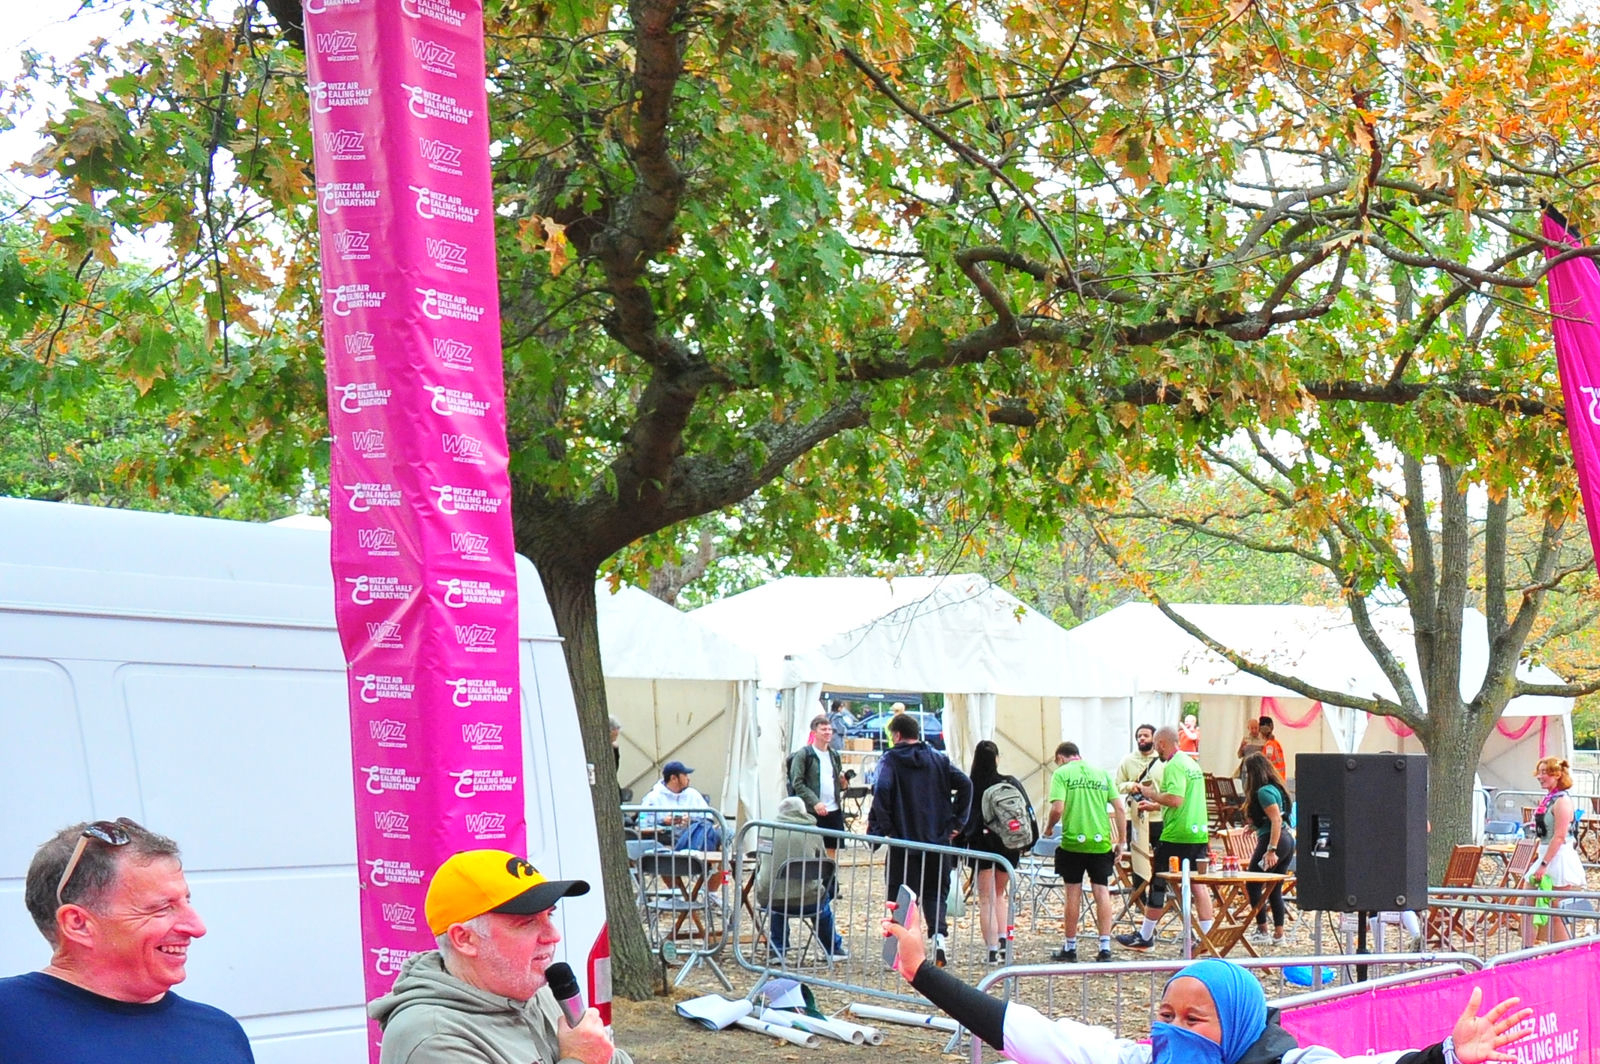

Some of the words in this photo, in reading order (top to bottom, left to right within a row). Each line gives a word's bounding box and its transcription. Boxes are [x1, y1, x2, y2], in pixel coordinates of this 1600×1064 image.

[329, 90, 354, 98] EALING
[424, 91, 444, 103] WIZZ
[444, 96, 456, 106] AIR
[424, 99, 453, 113] EALING
[455, 107, 473, 118] HALF
[424, 107, 469, 126] MARATHON
[1539, 1012, 1558, 1036] AIR
[1554, 1028, 1579, 1056] HALF
